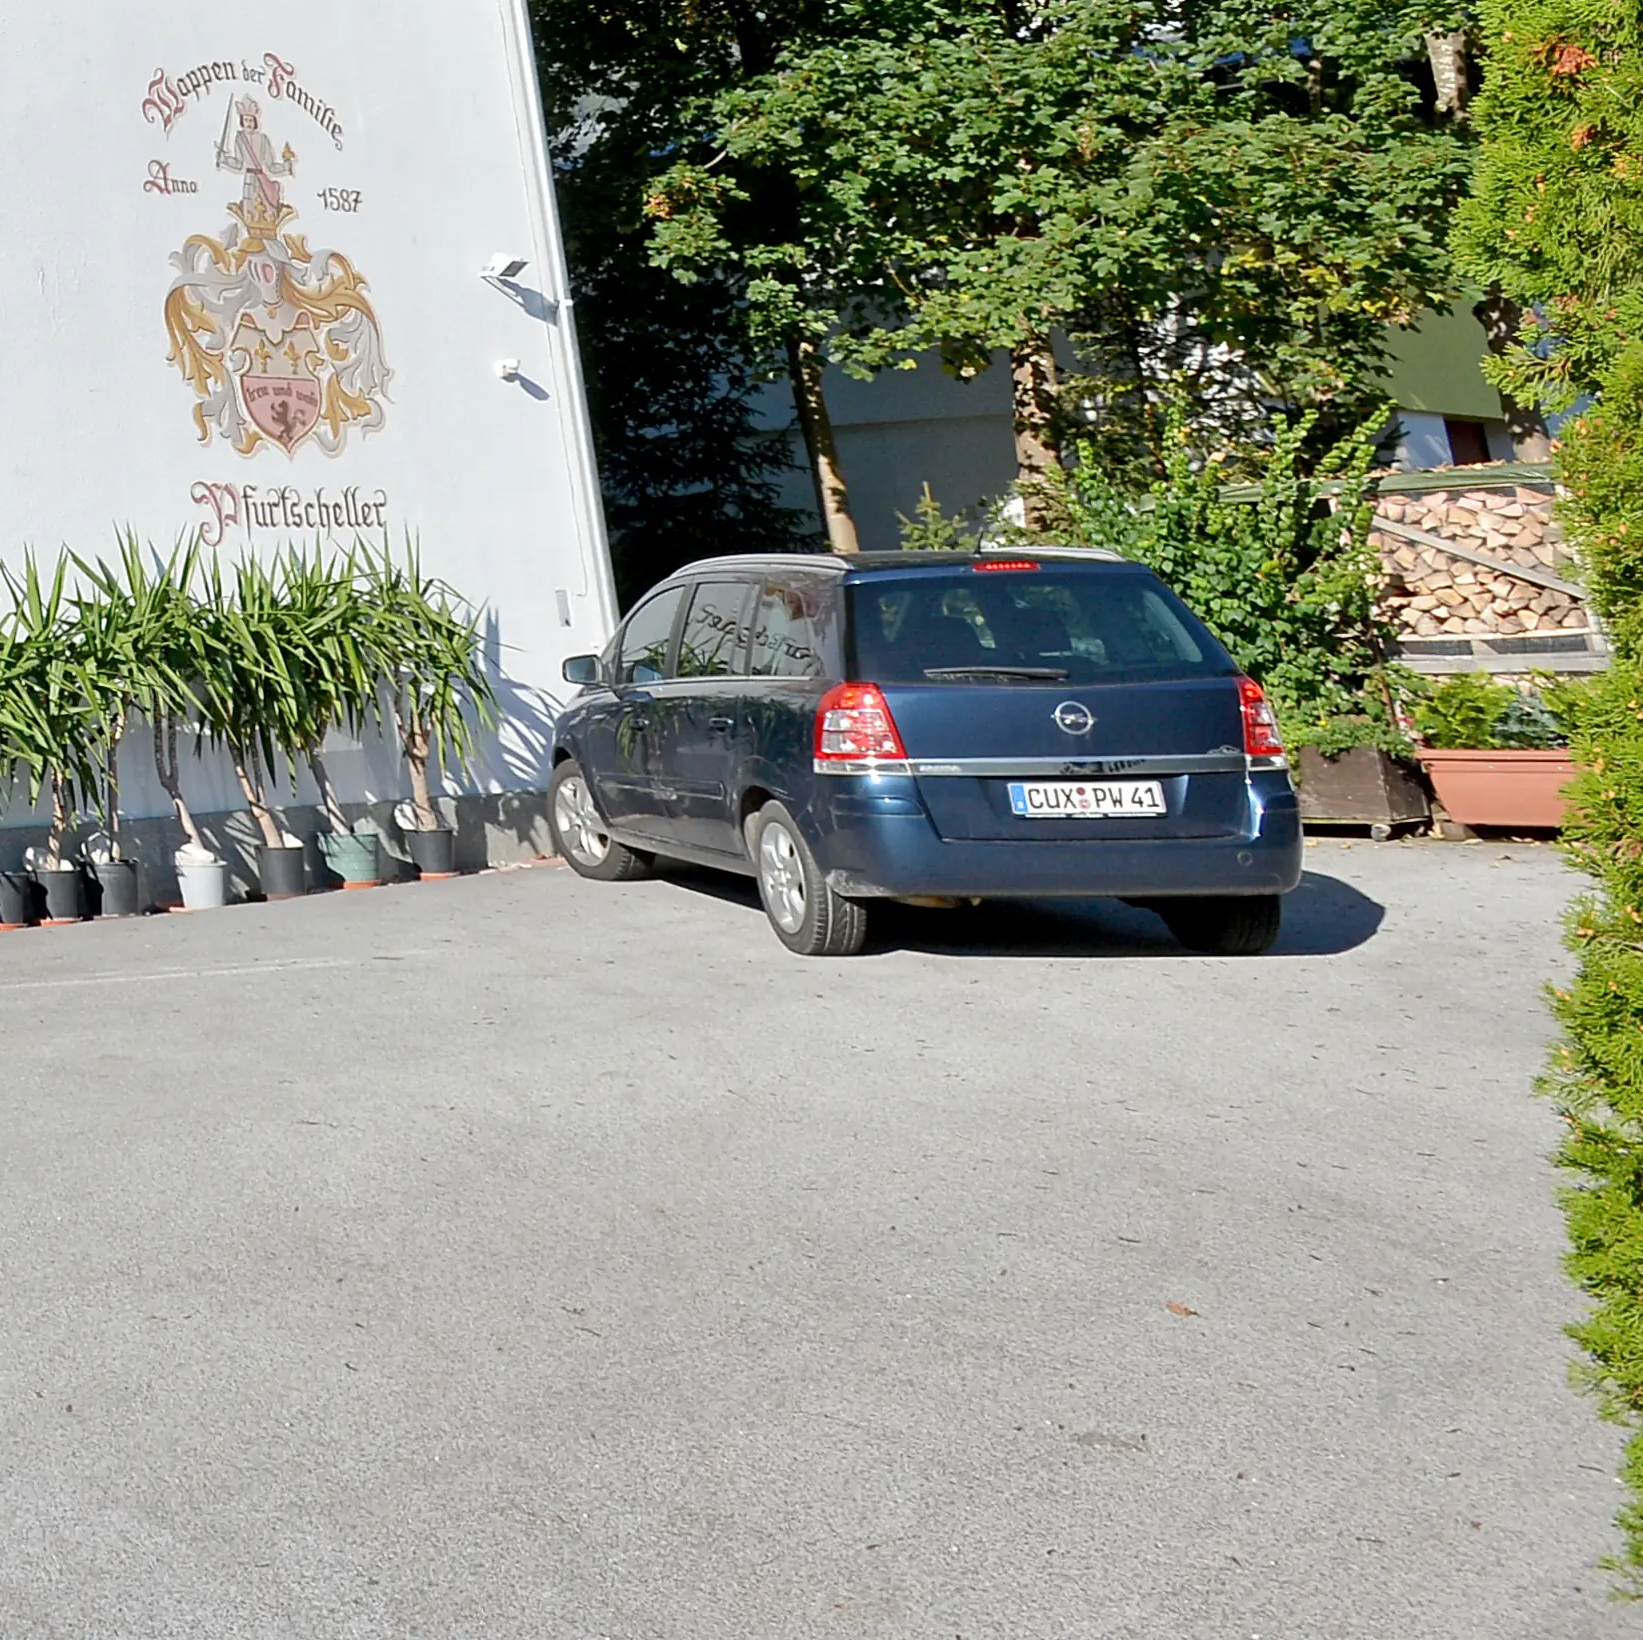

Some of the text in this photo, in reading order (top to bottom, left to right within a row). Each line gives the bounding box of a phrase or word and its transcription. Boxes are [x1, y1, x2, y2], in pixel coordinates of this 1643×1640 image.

[142, 52, 344, 152] Wappen der Familie
[143, 159, 363, 213] Anno 1587
[190, 480, 387, 548] Pfurtscheller
[1027, 785, 1161, 810] CUX PW 41
